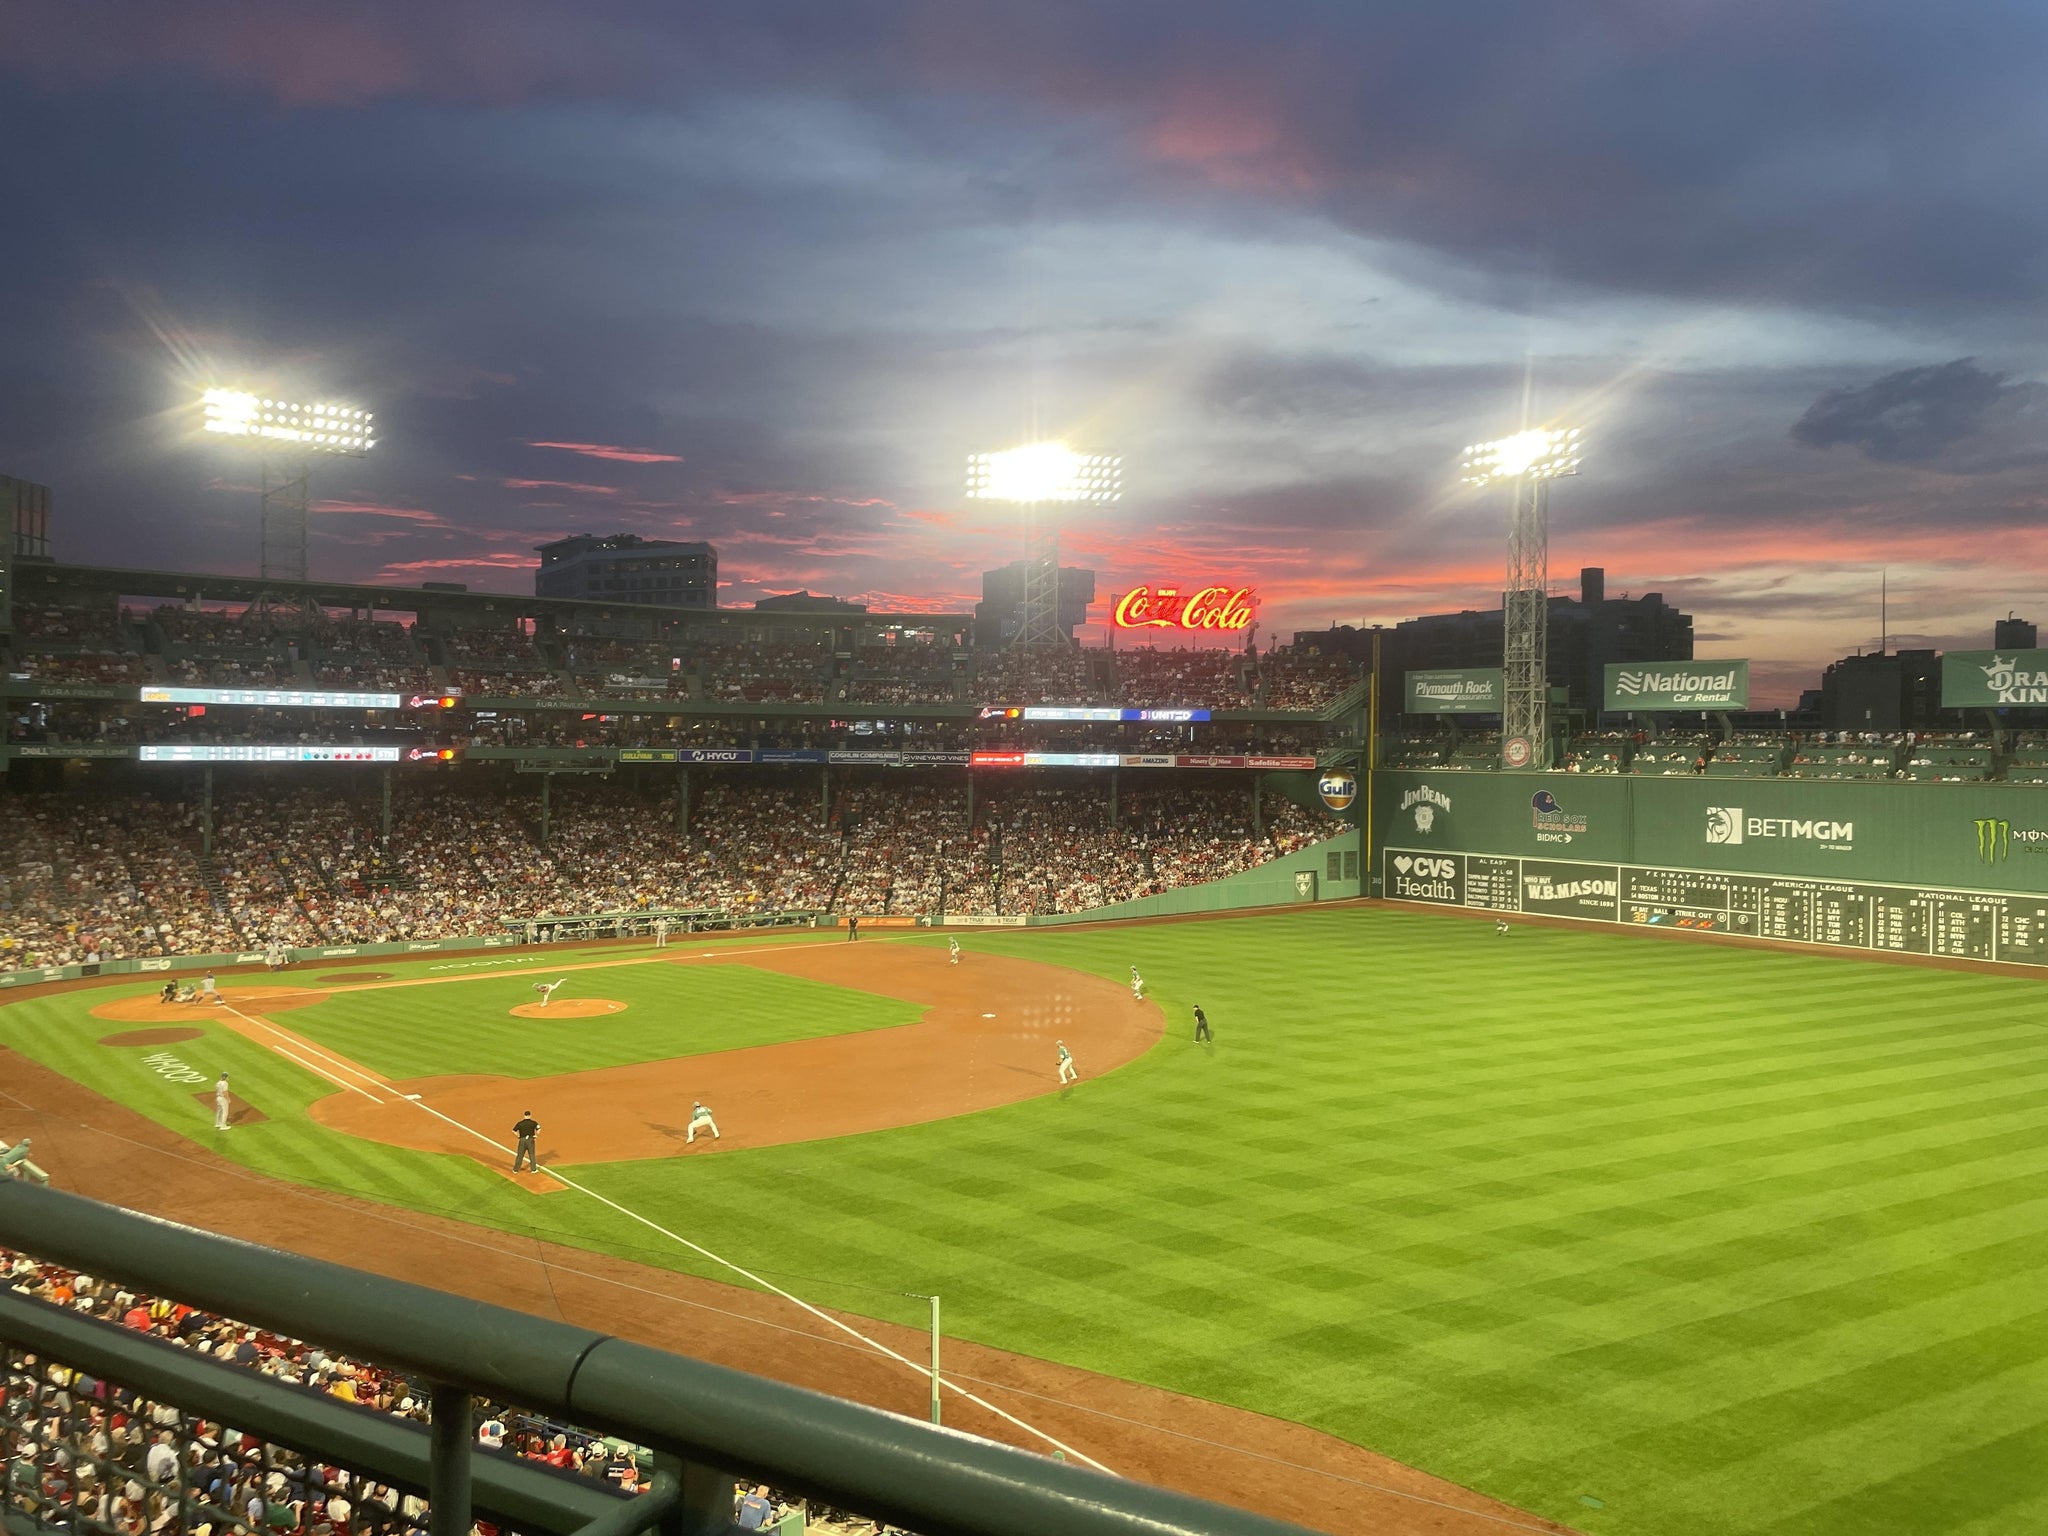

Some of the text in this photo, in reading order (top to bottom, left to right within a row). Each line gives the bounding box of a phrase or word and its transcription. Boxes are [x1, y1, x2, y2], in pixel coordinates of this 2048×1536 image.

[1642, 671, 1734, 692] National
[1415, 680, 1493, 697] Plymouth Rock
[1673, 693, 1730, 702] Car Rental
[1998, 687, 2048, 703] KIN
[1151, 711, 1191, 720] UNITED
[706, 752, 736, 760] HYCU
[860, 752, 899, 760] COMPANIES
[1189, 758, 1209, 766] Ninety
[1248, 759, 1281, 767] Safelite
[1319, 780, 1355, 796] Gulf
[1421, 785, 1451, 813] BEAM
[1537, 813, 1588, 825] RED SOX
[1537, 822, 1587, 833] SCHOLARS
[1747, 817, 1853, 841] BETMGM
[1537, 833, 1563, 843] BIDMC
[1479, 858, 1489, 866] AL
[1413, 857, 1456, 879] CVS
[1371, 877, 1382, 885] 310
[1523, 876, 1538, 884] WHO
[1646, 871, 1730, 883] FENWAY PARK
[1396, 876, 1456, 900] Health
[1771, 881, 1854, 893] AMERICAN LEAGUE
[1467, 893, 1490, 901] BALTIMORE
[1918, 892, 2007, 905] NATIONAL LEAGUE
[1653, 907, 1669, 915] BALL
[1675, 909, 1696, 918] STRIKE
[1698, 911, 1713, 919] OUT
[1890, 913, 1903, 921] MIN
[1890, 920, 1903, 928] MIA
[1773, 929, 1787, 937] CLE
[2015, 931, 2028, 939] PHI
[140, 1052, 208, 1083] WHOOP
